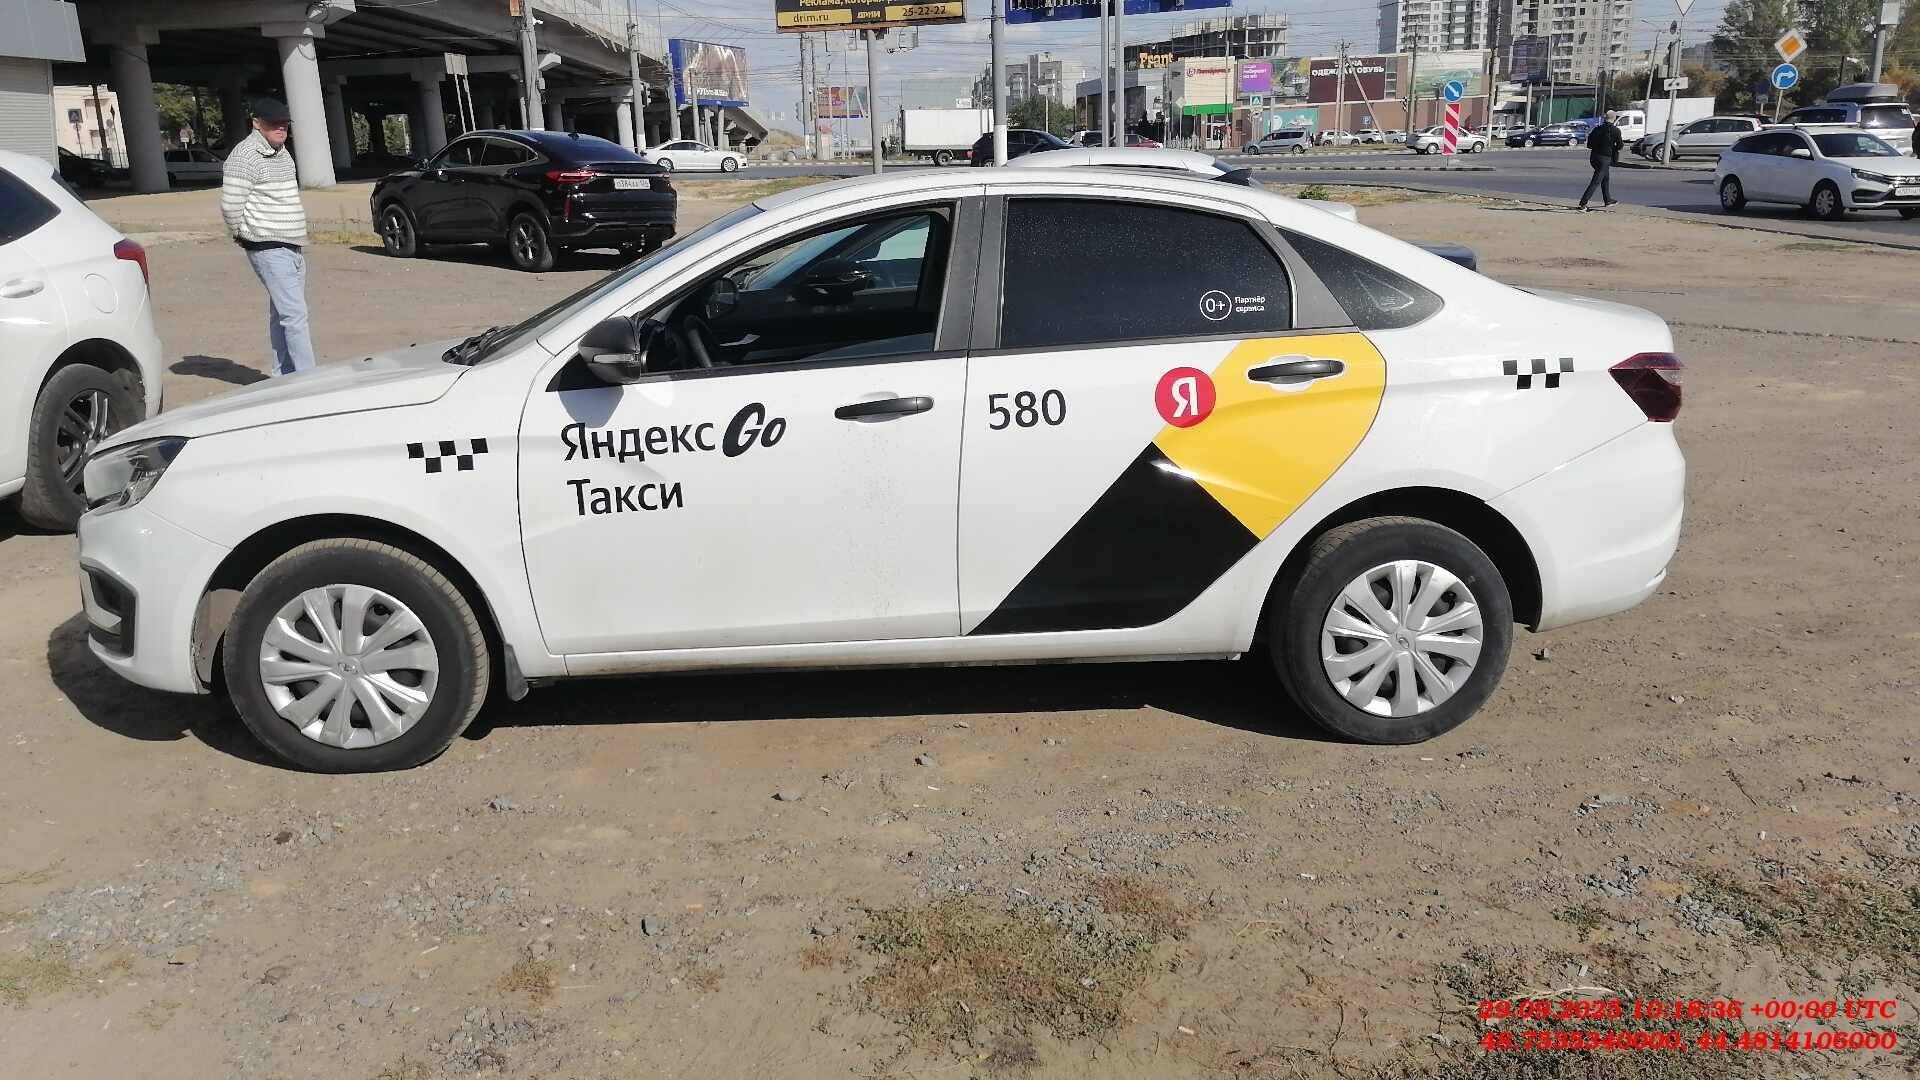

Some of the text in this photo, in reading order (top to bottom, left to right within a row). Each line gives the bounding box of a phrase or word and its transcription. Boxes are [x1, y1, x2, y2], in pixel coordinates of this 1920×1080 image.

[793, 12, 829, 23] drim.ru
[902, 5, 946, 17] 25-22-22
[1205, 298, 1226, 312] 0+
[988, 389, 1067, 430] 580
[1171, 376, 1199, 418] Я
[561, 402, 787, 463] Яндекс Go
[567, 478, 683, 516] Такси
